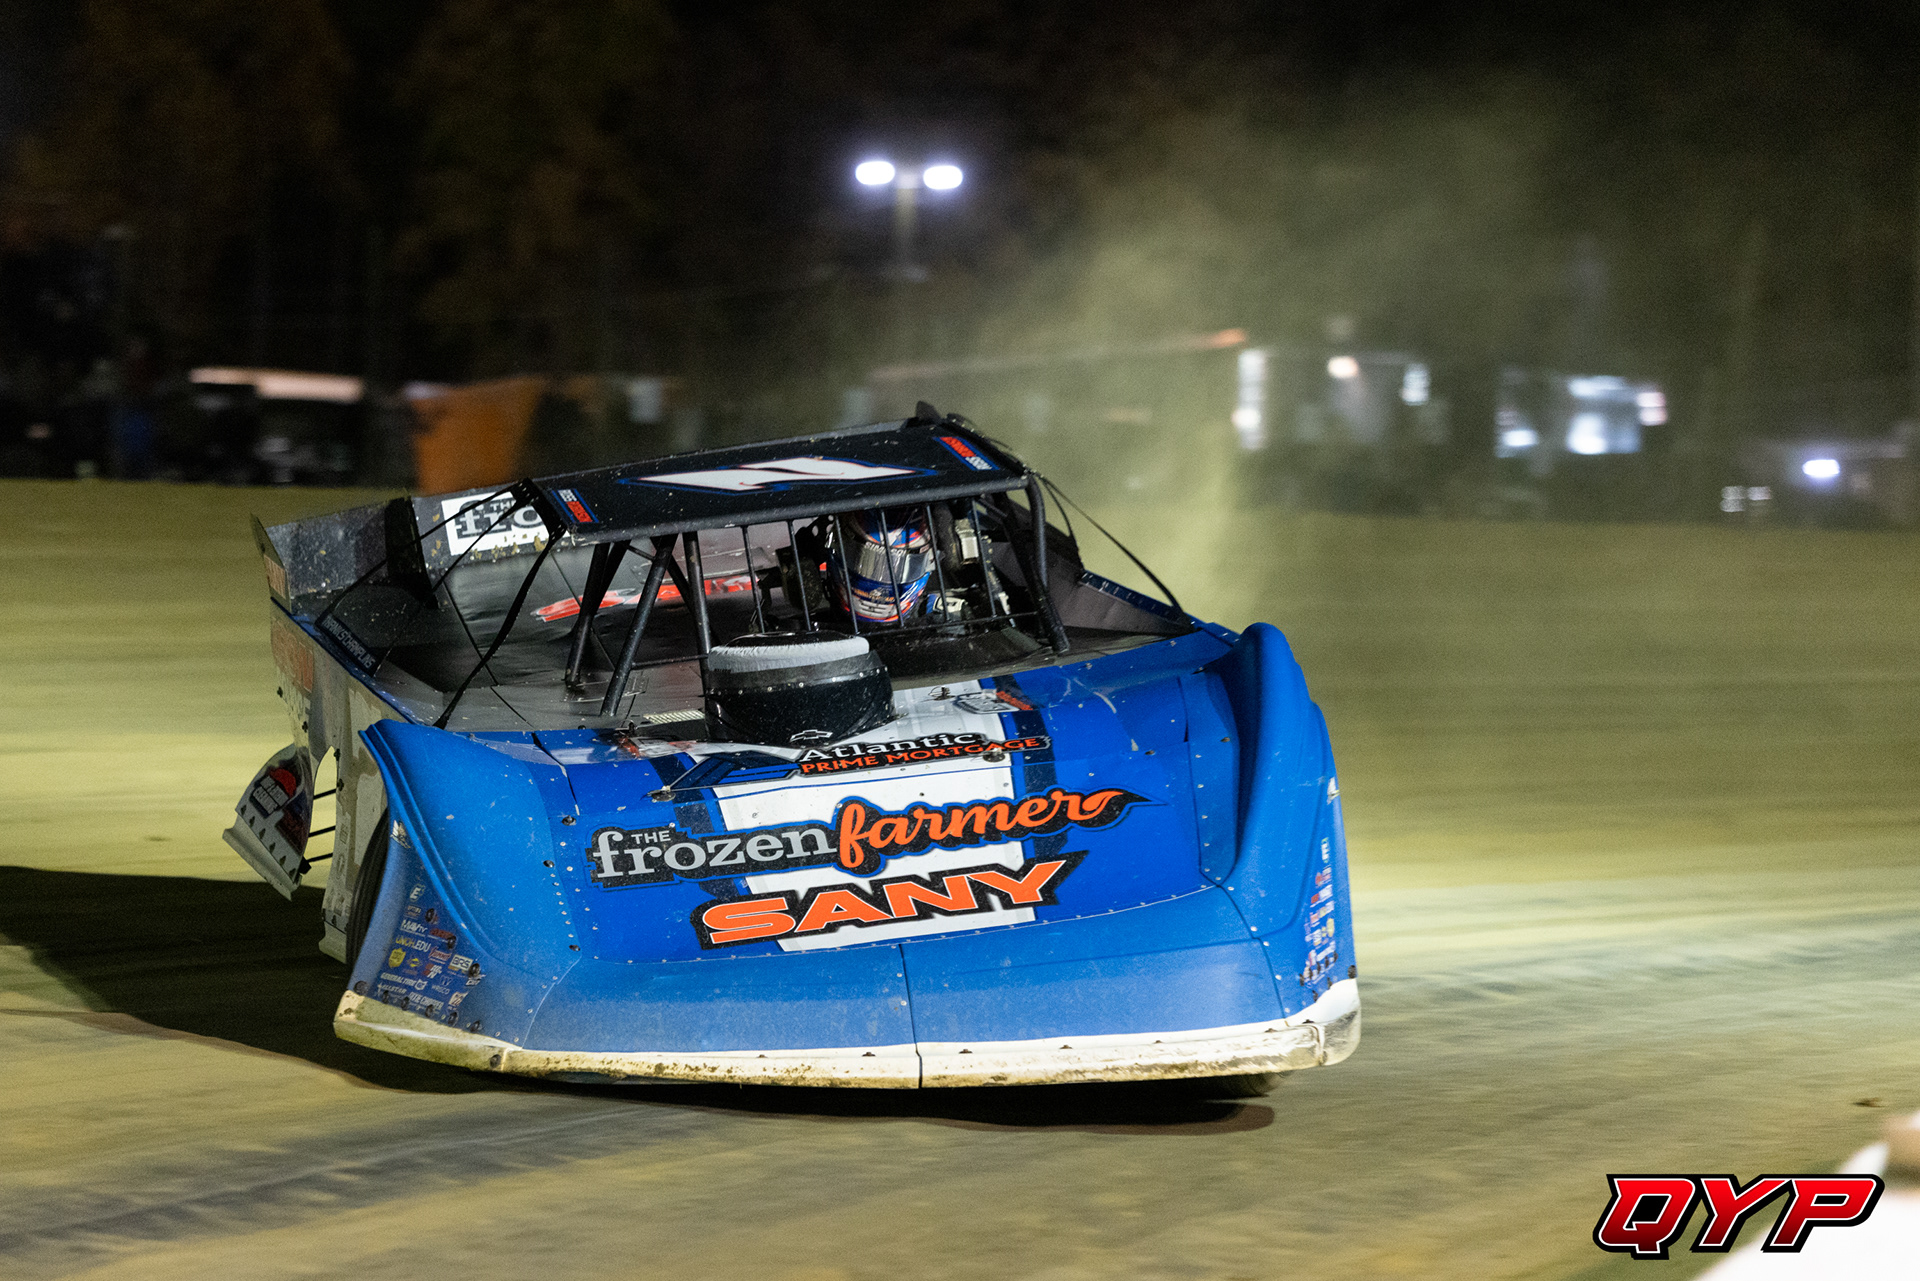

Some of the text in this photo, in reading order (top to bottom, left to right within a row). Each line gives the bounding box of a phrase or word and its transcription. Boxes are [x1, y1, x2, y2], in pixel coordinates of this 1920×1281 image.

[799, 734, 977, 763] Atlantic
[801, 737, 1040, 774] PRIME MORTGAGE
[593, 790, 1124, 879] frozen farmer
[631, 830, 672, 845] THE
[702, 859, 1067, 944] SANY
